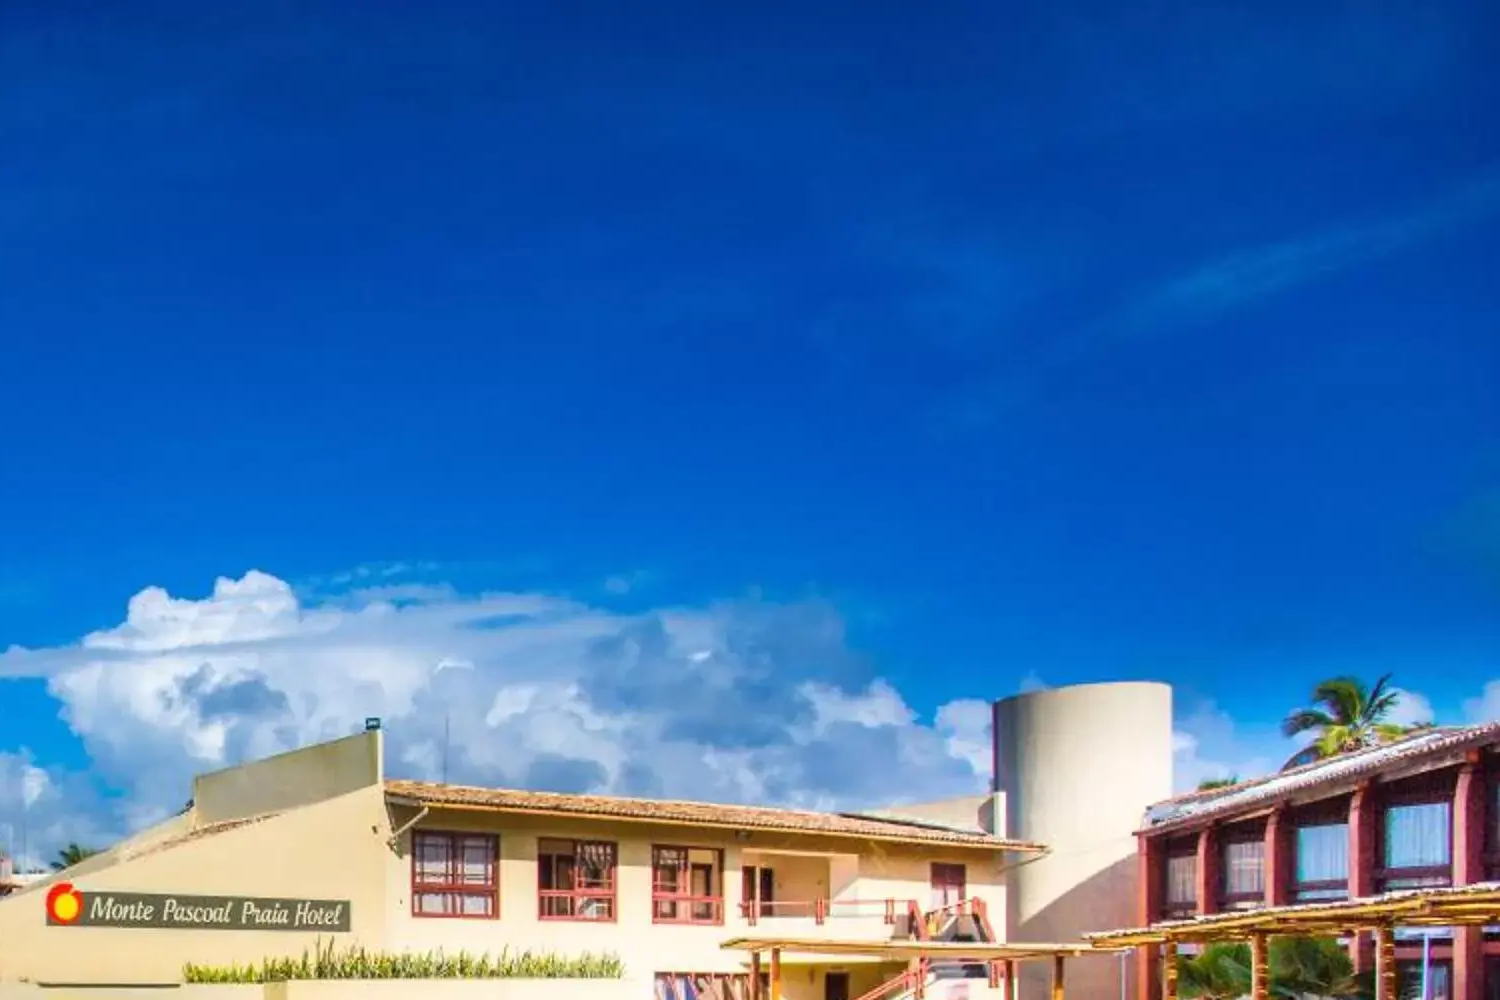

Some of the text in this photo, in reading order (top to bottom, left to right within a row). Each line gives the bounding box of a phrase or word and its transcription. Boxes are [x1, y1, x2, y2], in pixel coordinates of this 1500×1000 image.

[90, 896, 344, 927] Monte Pascoal Praia Hotel
